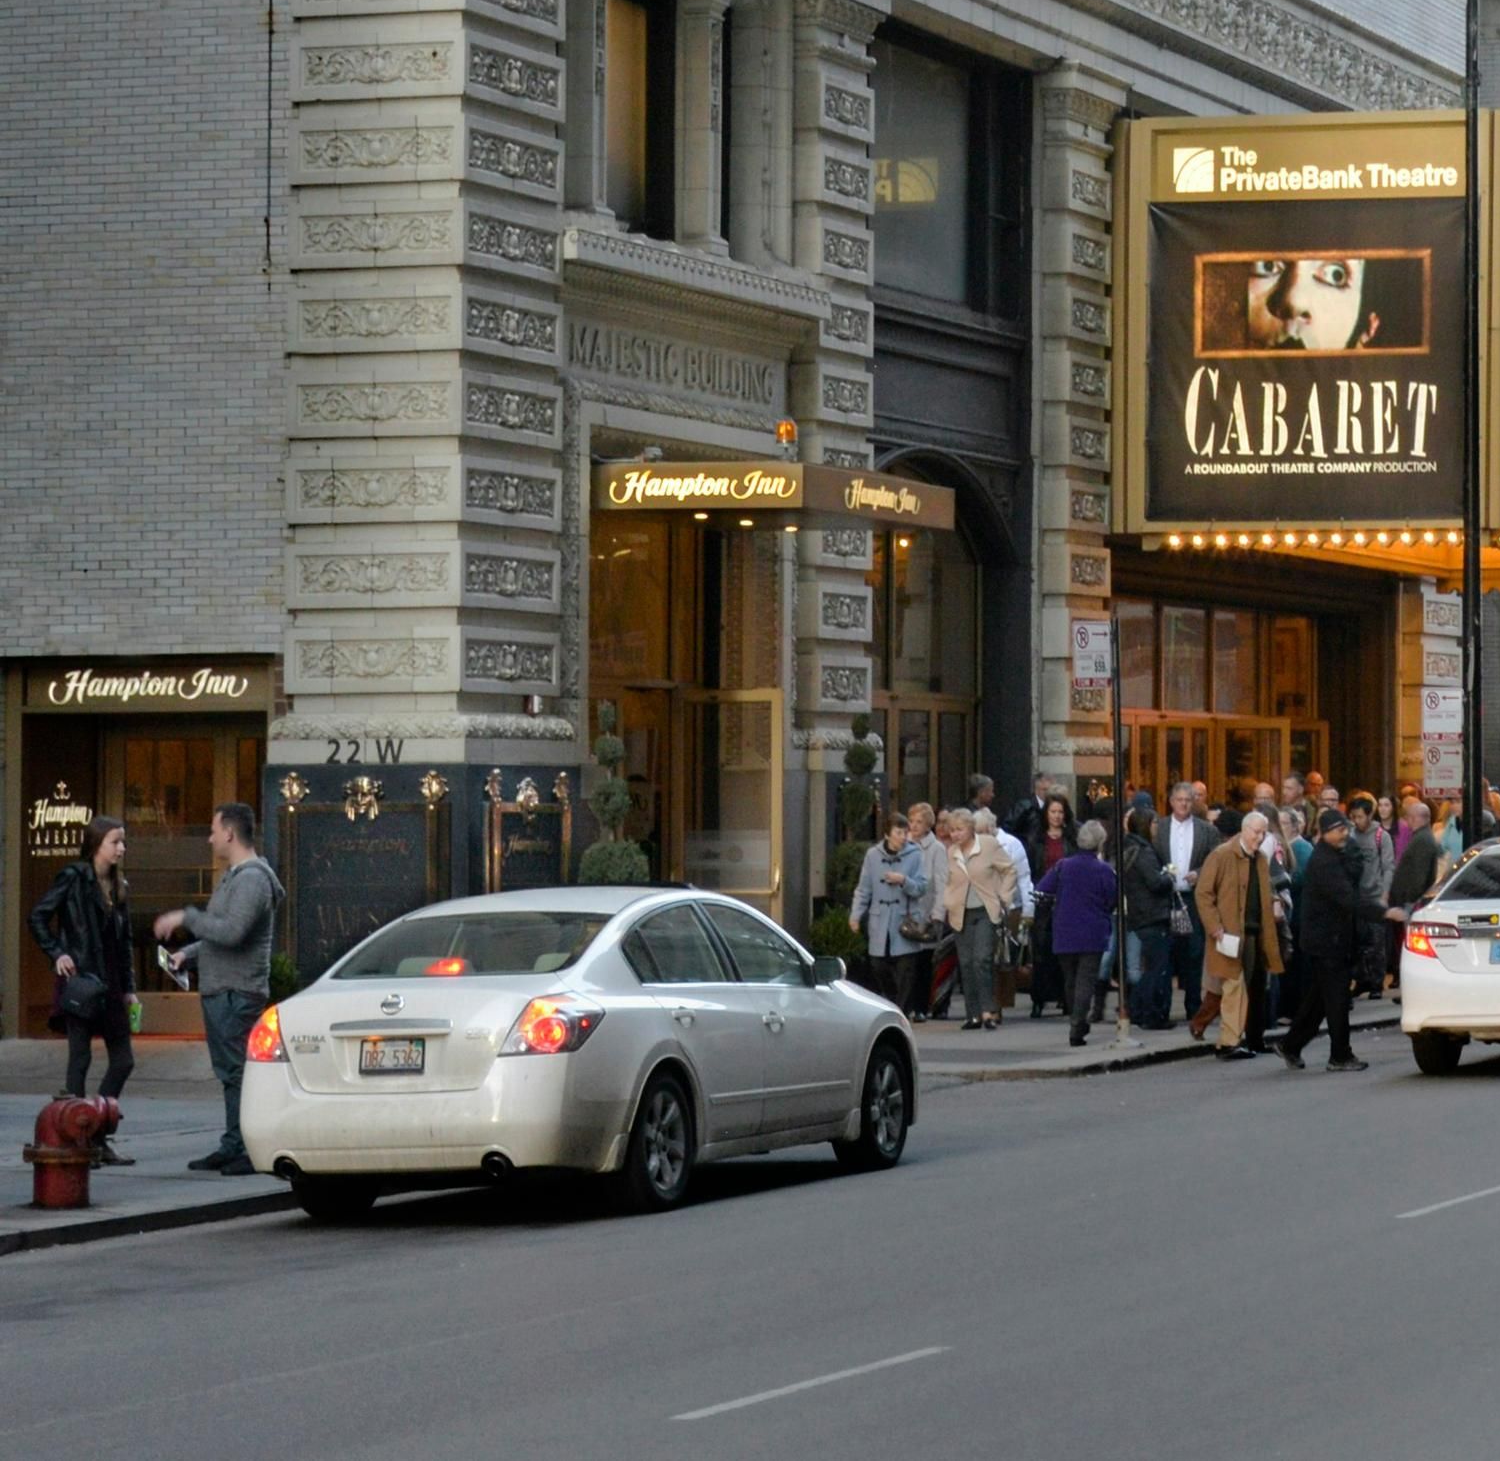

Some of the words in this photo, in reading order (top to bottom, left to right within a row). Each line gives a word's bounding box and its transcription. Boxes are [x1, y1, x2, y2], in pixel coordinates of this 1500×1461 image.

[1221, 146, 1257, 167] The
[1220, 164, 1362, 192] PrivateBank
[1365, 162, 1458, 188] Theatre
[569, 322, 680, 381] MAJESTIC
[684, 348, 773, 405] BUILDING
[1185, 366, 1438, 458] CABARET
[1185, 464, 1193, 475] A
[1194, 463, 1269, 475] ROUNDABOUT
[1271, 462, 1315, 474] THEATRE
[1317, 462, 1371, 474] COMPANY
[1373, 461, 1437, 473] PRODUCTION
[609, 469, 728, 505] Hampton
[730, 470, 796, 500] Inn
[845, 478, 896, 512] Hampton
[49, 668, 179, 705] Hampton
[178, 667, 249, 700] Inn
[326, 739, 361, 764] 22
[376, 740, 404, 764] W
[28, 799, 93, 829] Hampton
[290, 1035, 327, 1044] ALTIMA
[392, 1049, 421, 1069] 5362
